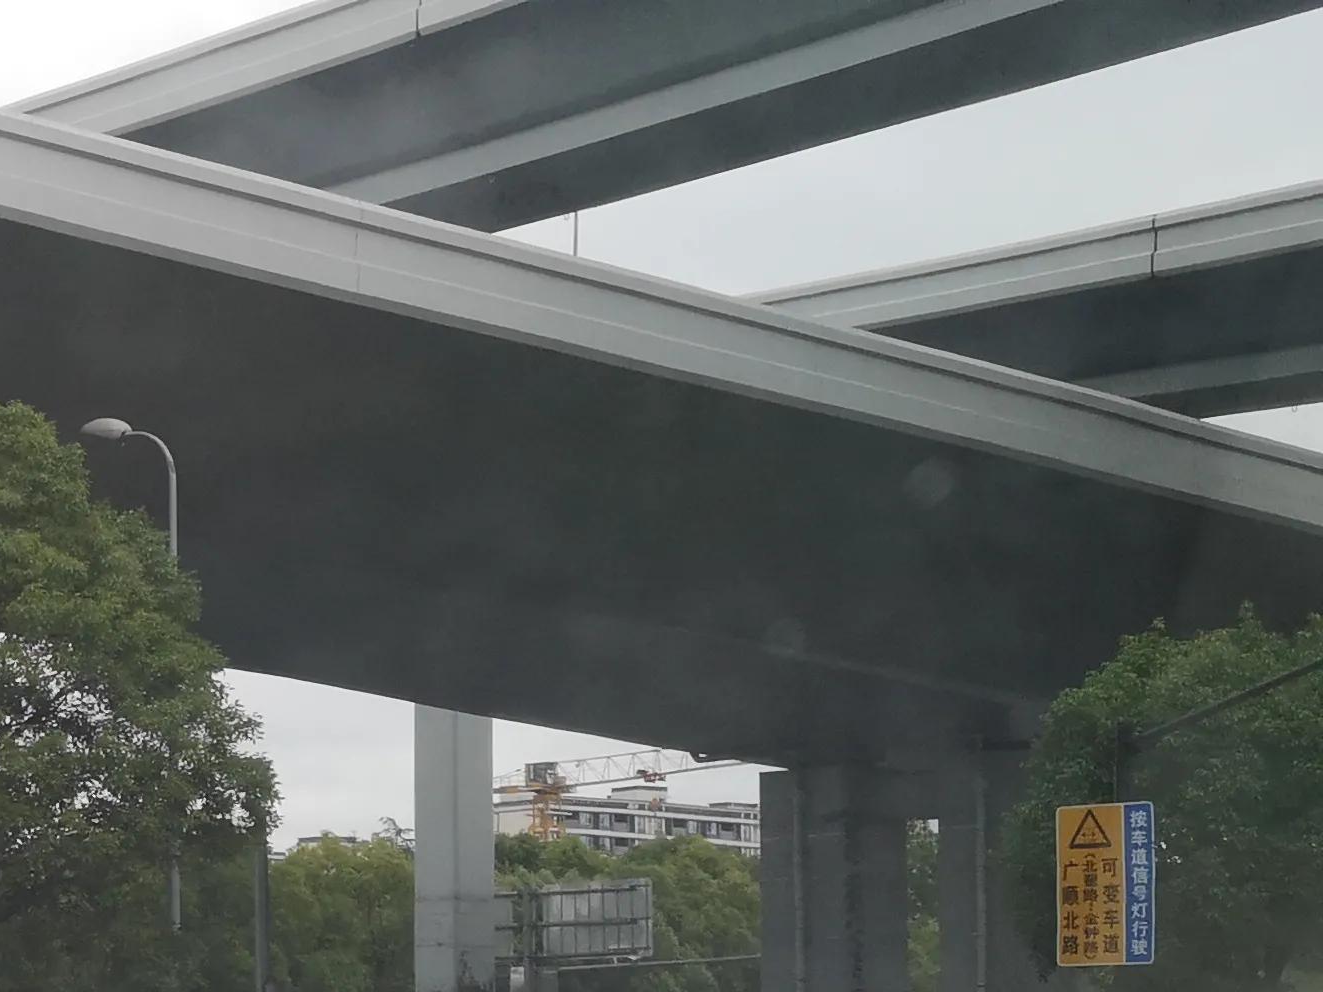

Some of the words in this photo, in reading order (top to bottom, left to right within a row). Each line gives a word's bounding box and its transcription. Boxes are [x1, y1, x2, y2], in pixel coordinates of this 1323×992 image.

[1062, 860, 1079, 955] 广顺北路
[1101, 858, 1120, 954] 可变车道
[1129, 811, 1148, 956] 按车道信号灯行驶
